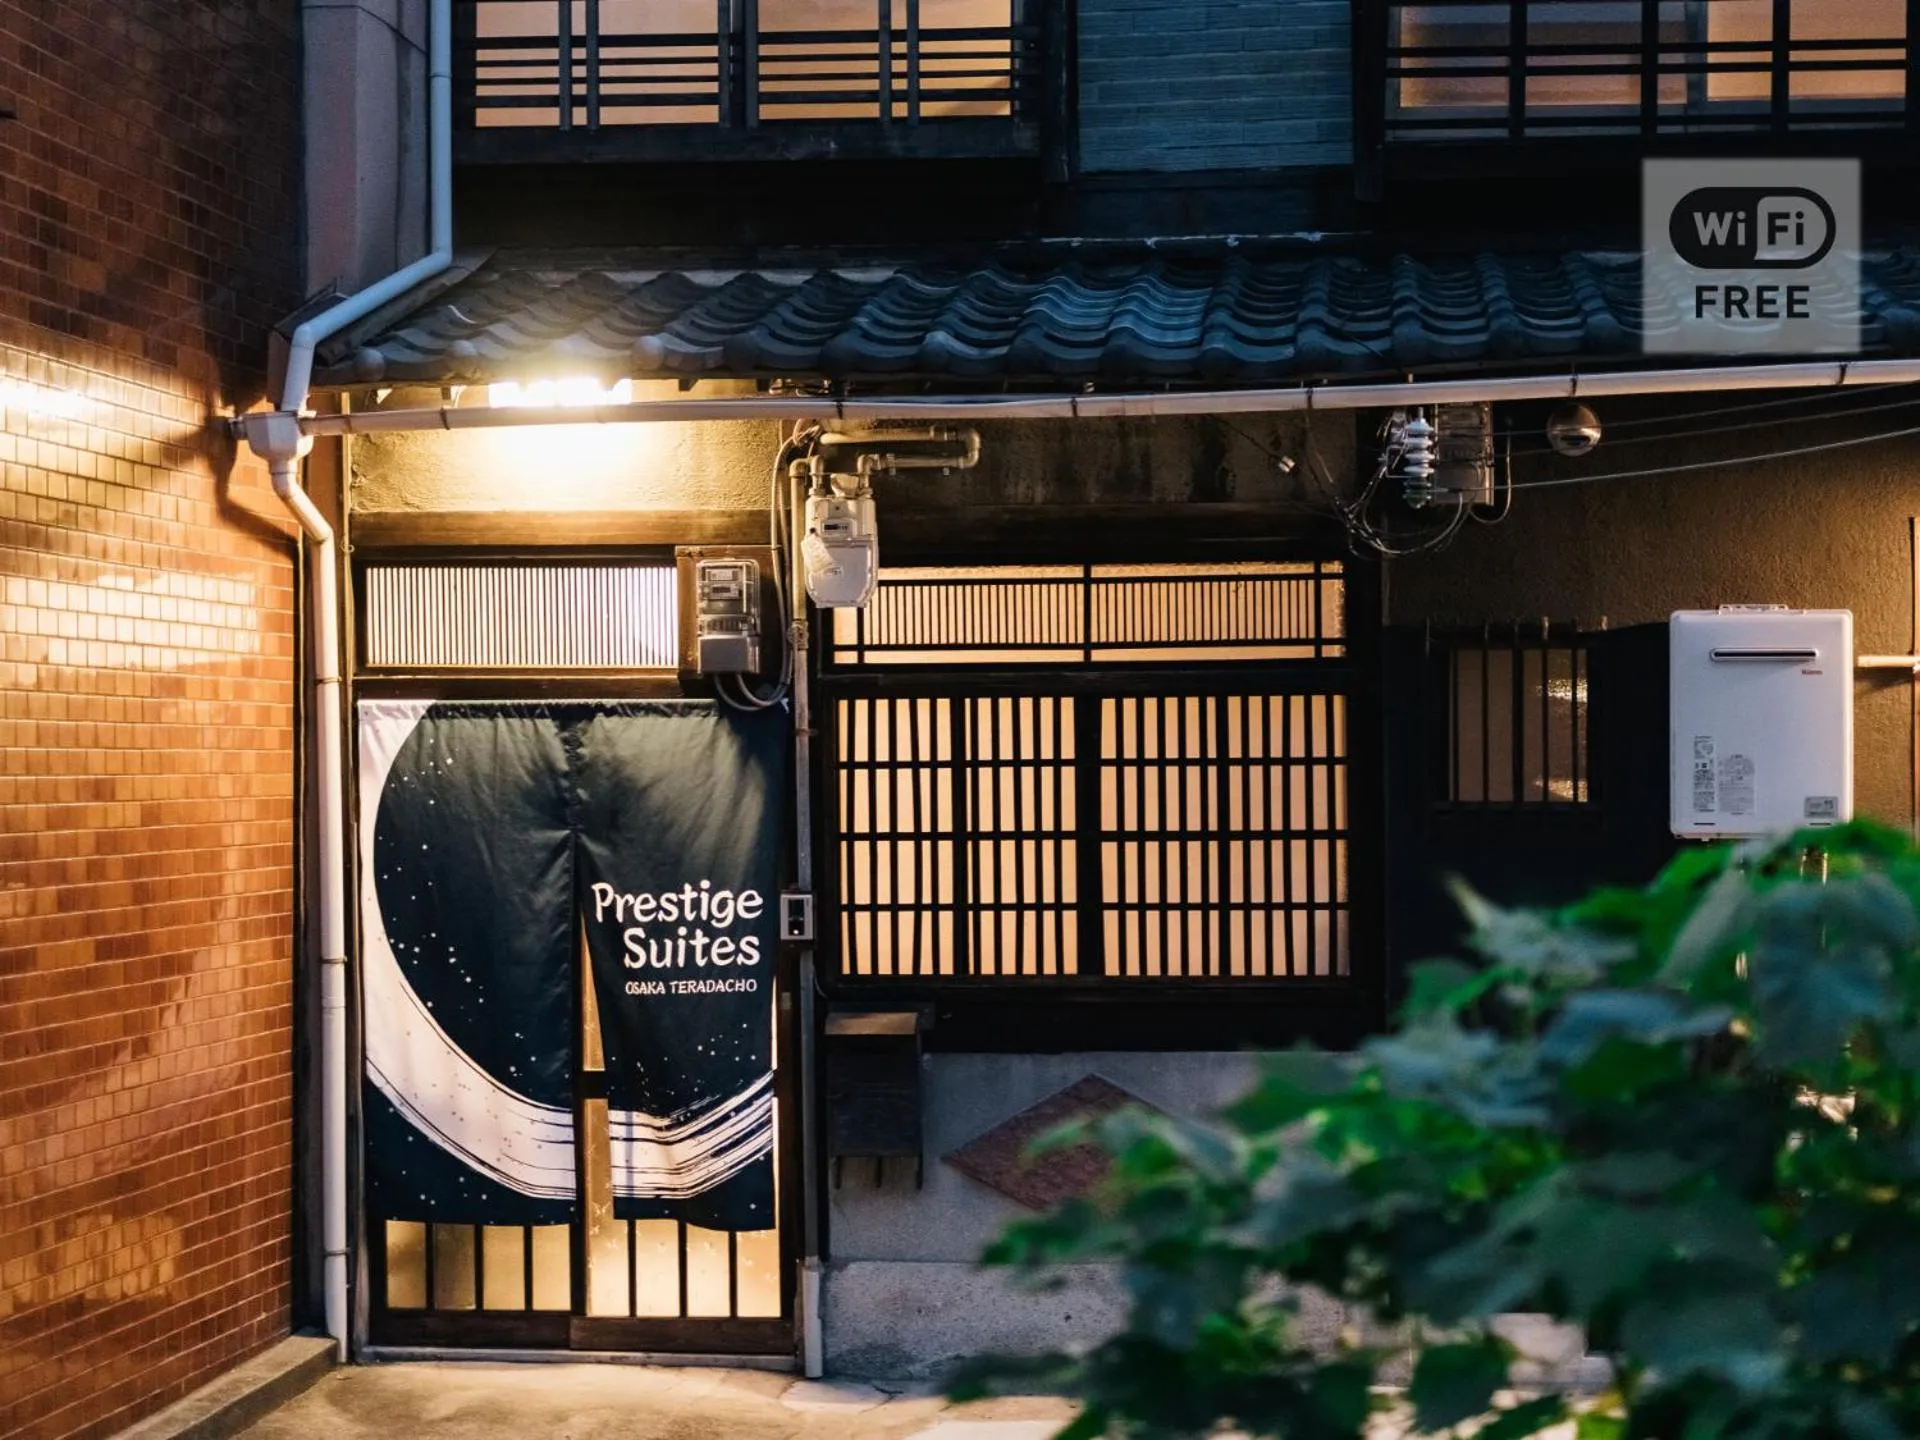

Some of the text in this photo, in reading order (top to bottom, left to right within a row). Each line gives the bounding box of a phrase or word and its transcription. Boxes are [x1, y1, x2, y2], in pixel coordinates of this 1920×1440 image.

[591, 879, 764, 928] Prestige
[623, 926, 761, 969] Suites
[625, 979, 757, 995] OSAKA TERADACHO
